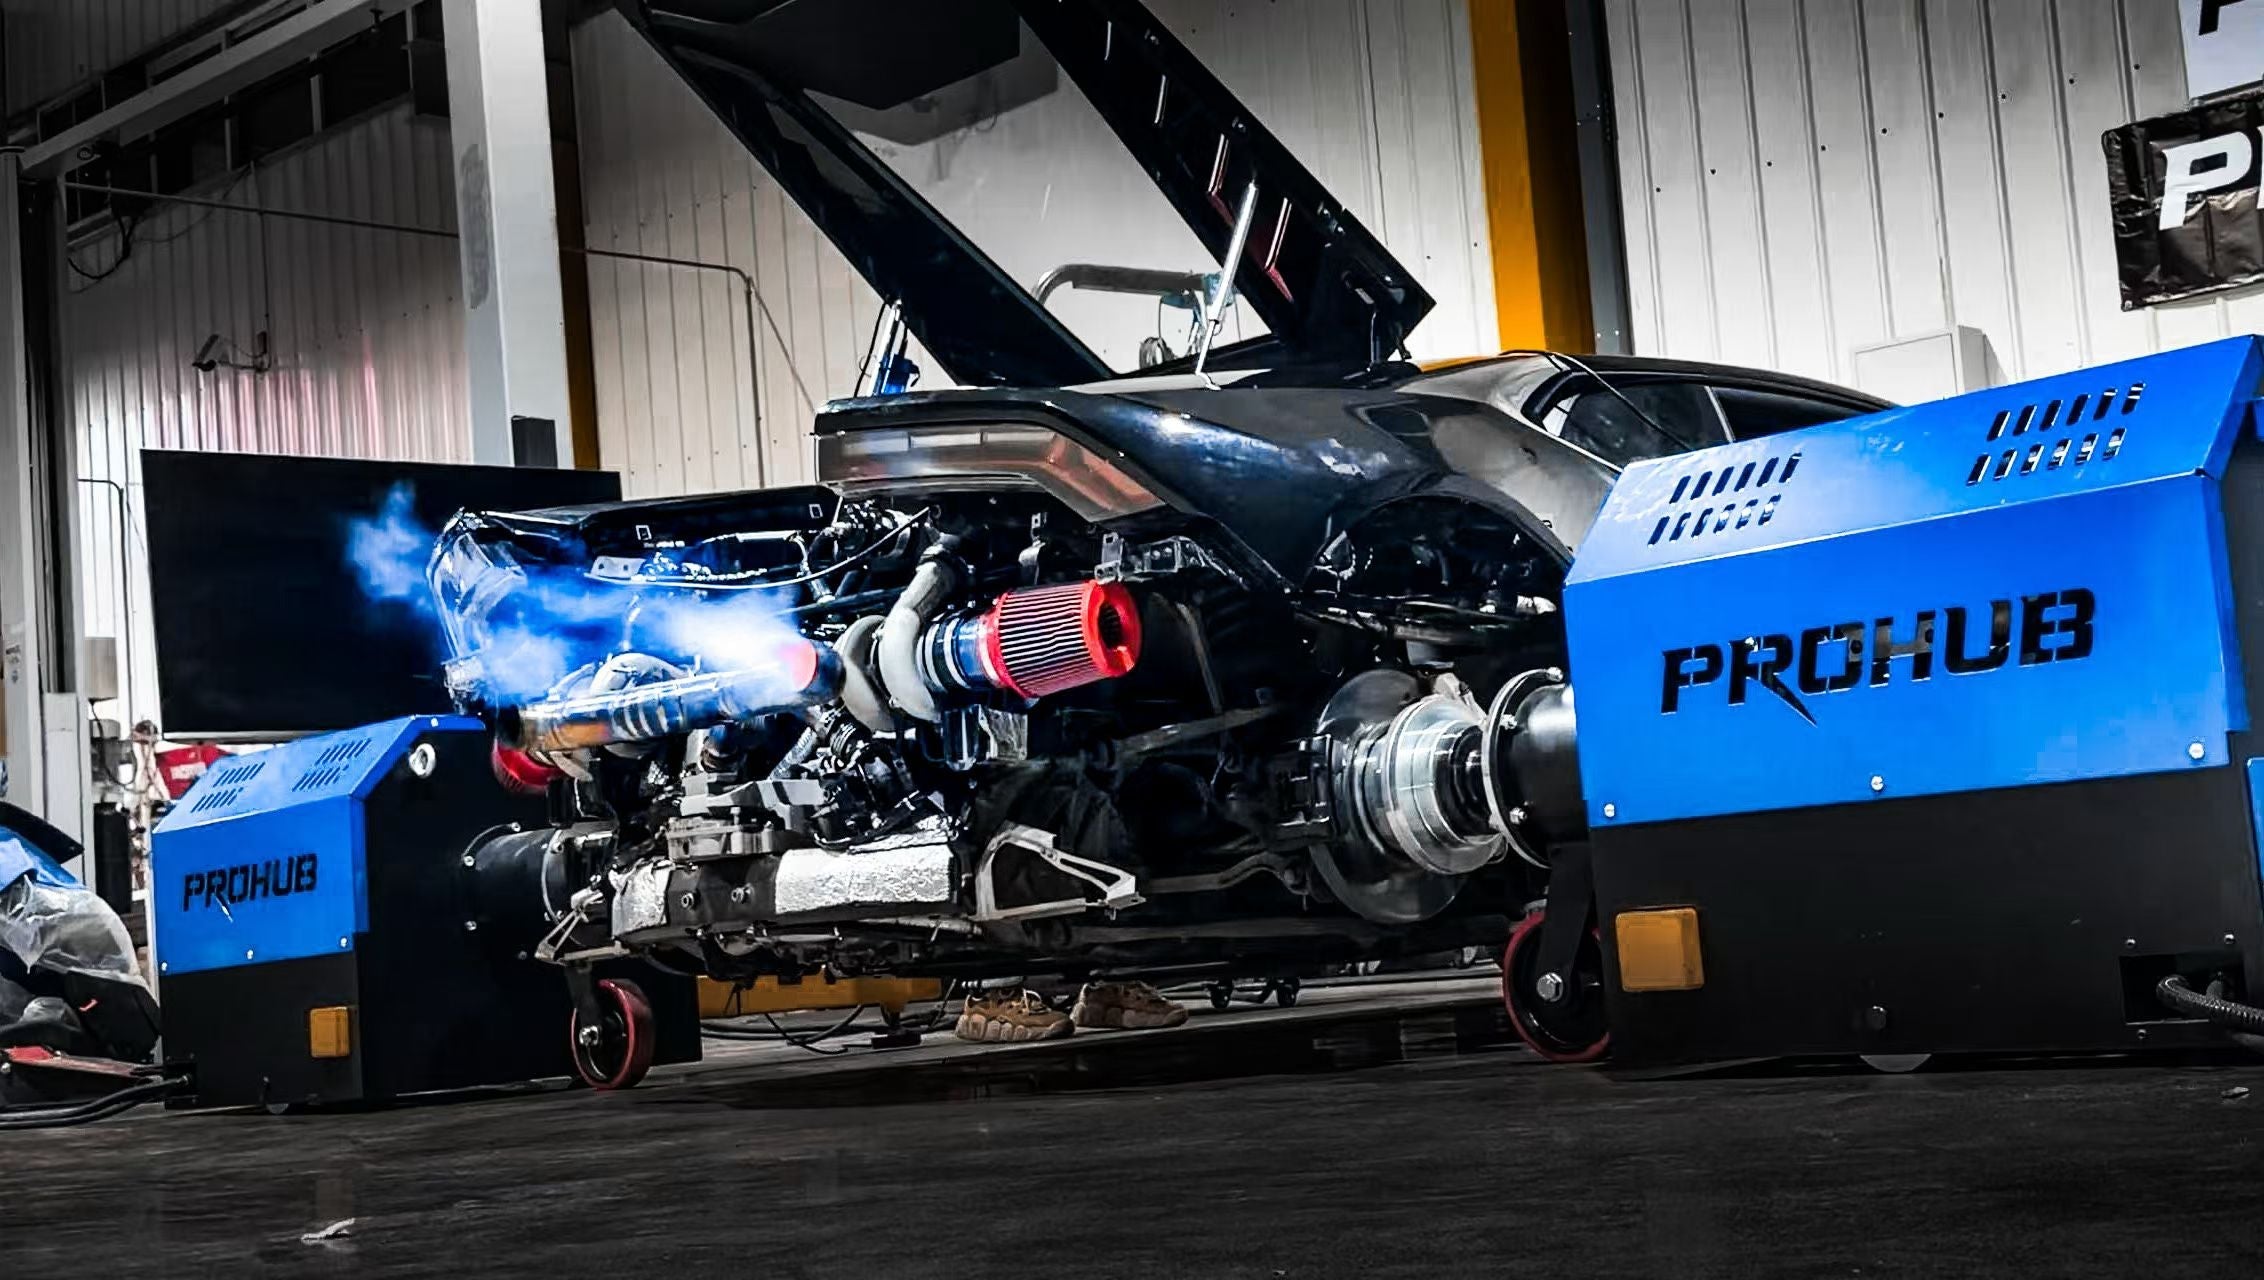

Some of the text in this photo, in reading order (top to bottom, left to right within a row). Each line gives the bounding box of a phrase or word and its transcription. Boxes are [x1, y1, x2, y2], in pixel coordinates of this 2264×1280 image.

[2159, 127, 2264, 230] P
[1661, 587, 2097, 727] PROHUB
[182, 853, 318, 923] PROHUB
